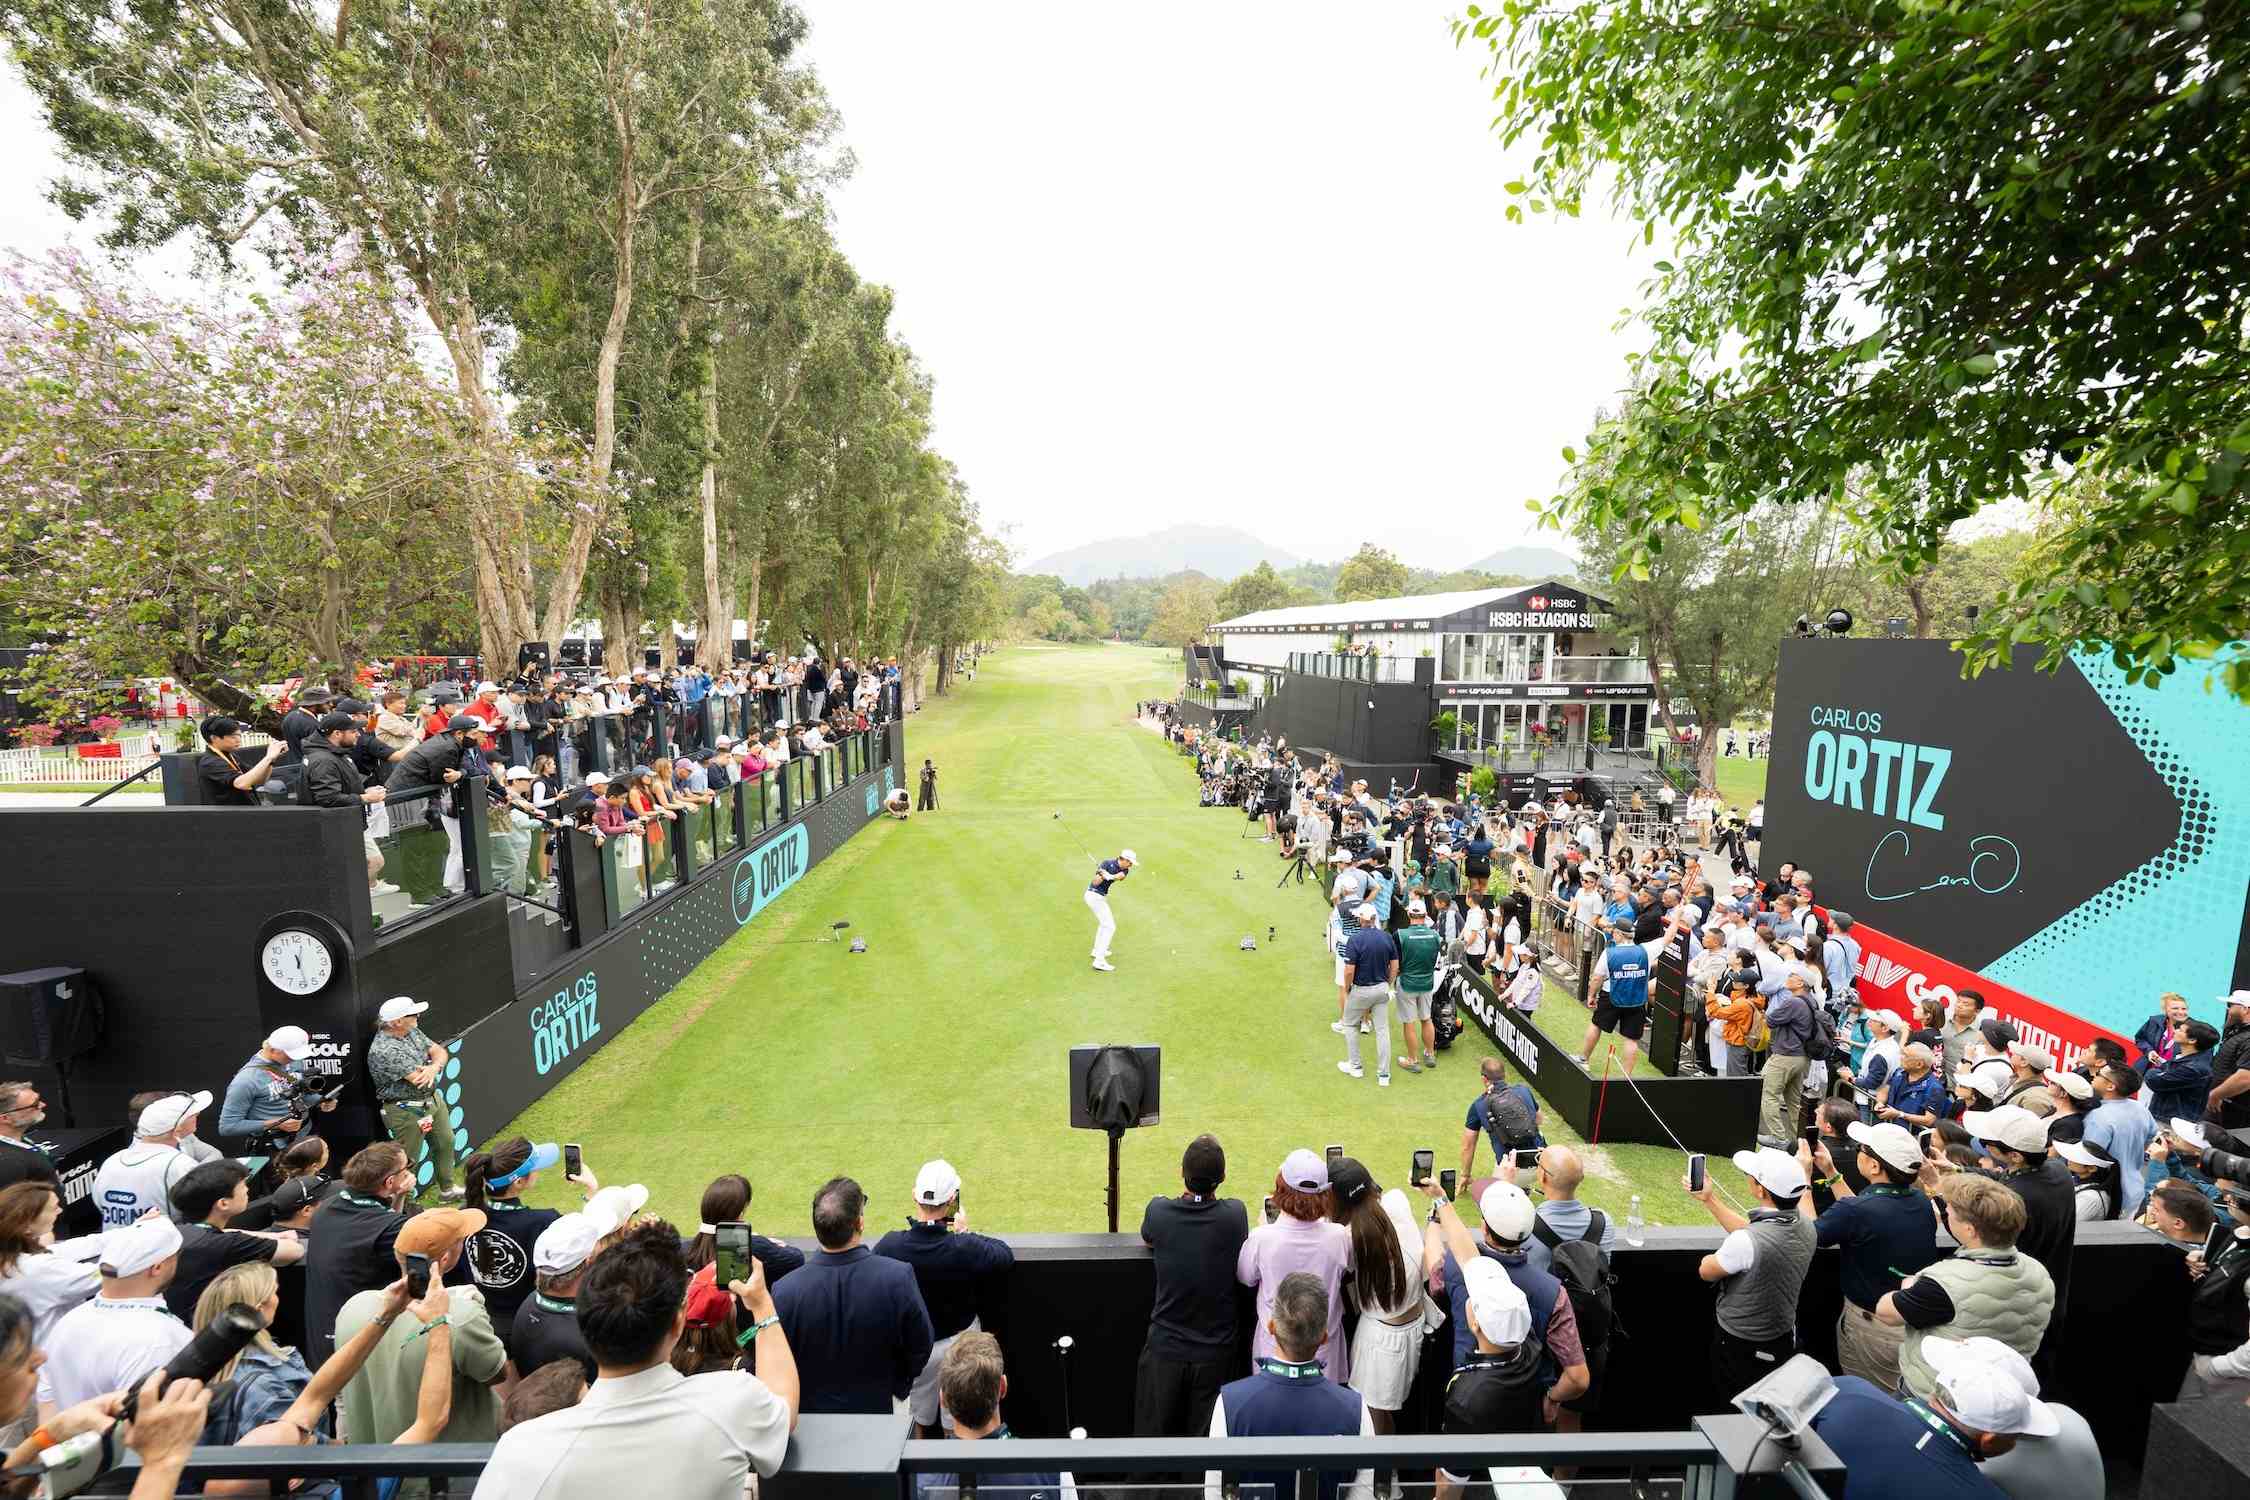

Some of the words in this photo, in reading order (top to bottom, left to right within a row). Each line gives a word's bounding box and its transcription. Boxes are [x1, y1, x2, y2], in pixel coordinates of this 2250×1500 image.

[1489, 612, 1522, 627] HSBC
[1524, 612, 1577, 628] HEXAGON
[1551, 599, 1576, 608] HSBC
[1811, 706, 1882, 733] CARLOS
[1805, 729, 1952, 831] ORTIZ
[761, 834, 798, 898] ORTIZ
[1613, 969, 1646, 979] VOLUNTEER
[1856, 951, 1912, 989] IV
[530, 971, 597, 1032] CARLOS
[534, 991, 600, 1075] ORTIZ
[1461, 980, 1495, 1028] GOLF
[1495, 1010, 1517, 1053] HONG
[1516, 1029, 1539, 1075] KONG
